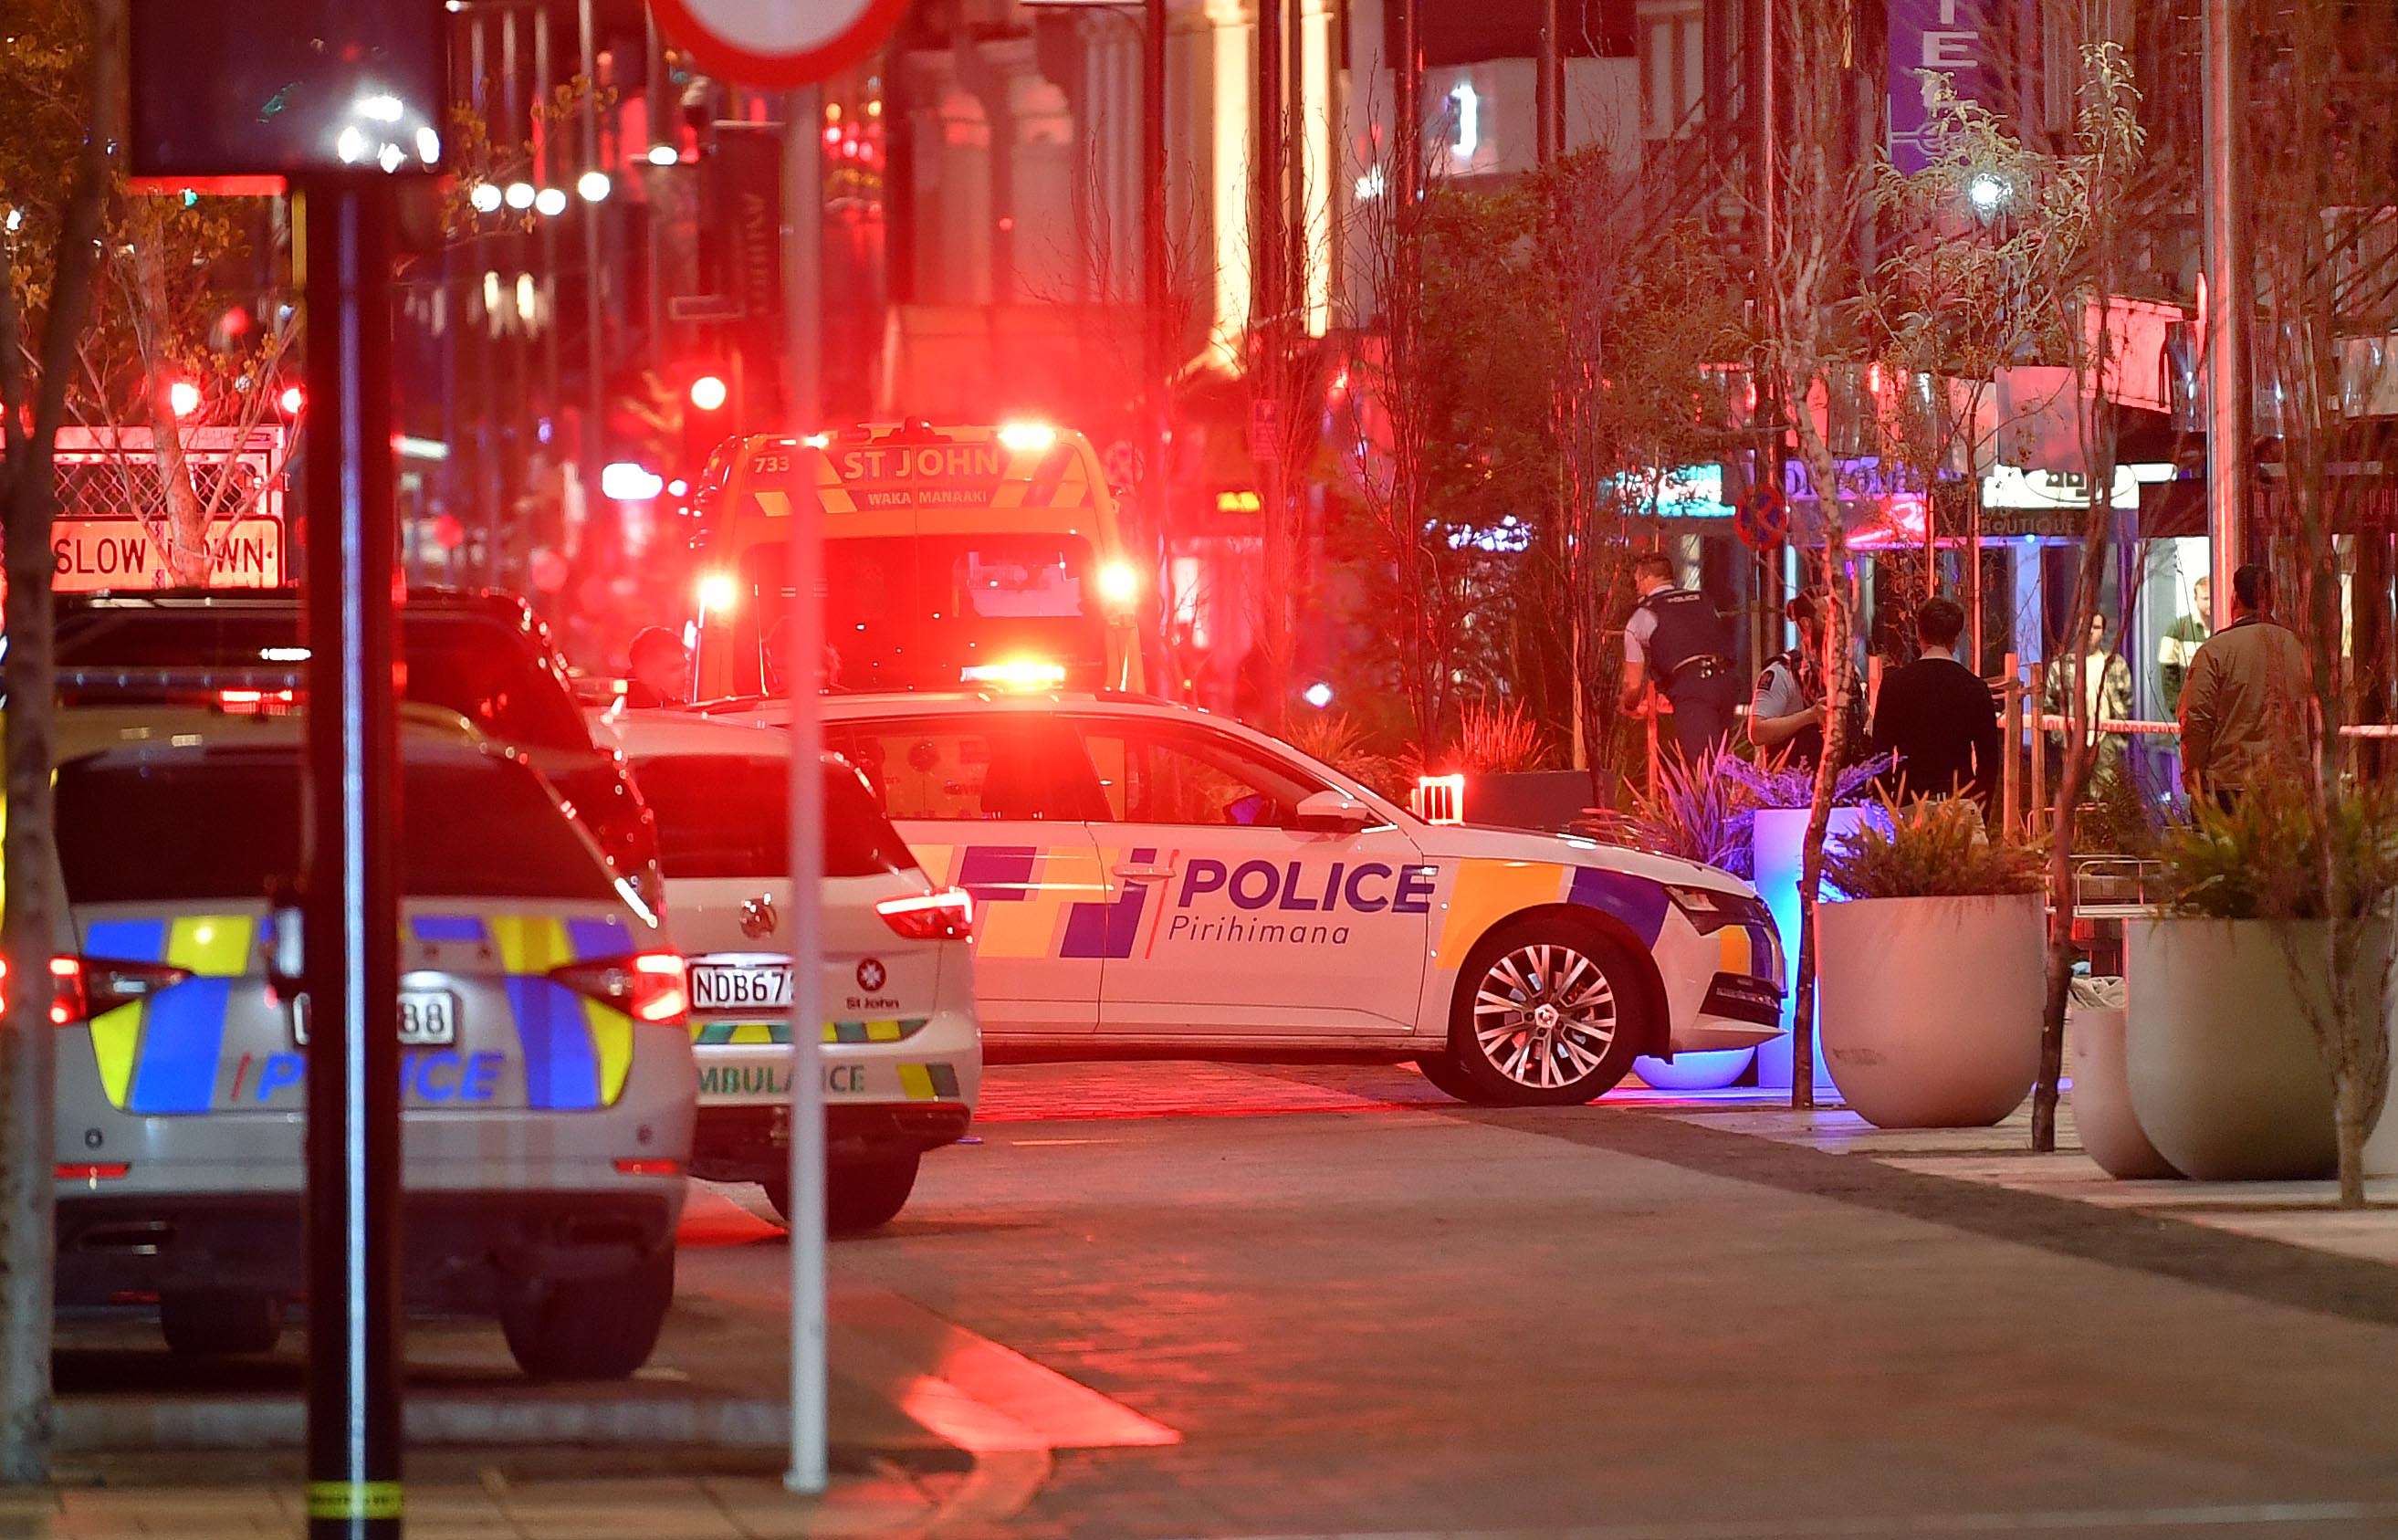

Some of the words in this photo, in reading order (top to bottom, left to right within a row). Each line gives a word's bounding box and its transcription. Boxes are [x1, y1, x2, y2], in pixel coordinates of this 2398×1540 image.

[754, 456, 791, 473] 733
[844, 450, 885, 479] ST
[895, 446, 998, 477] JOHN
[868, 491, 911, 506] WAKA
[918, 490, 987, 504] MANAAKI
[1980, 518, 2075, 534] BOUTIQUE
[54, 538, 146, 574] SLOW
[168, 538, 264, 574] WN
[1178, 859, 1440, 913] POLICE
[1168, 915, 1350, 944] Pirihimana
[696, 971, 794, 1002] NDB67
[846, 997, 861, 1010] St
[864, 997, 900, 1009] John
[257, 1052, 504, 1101] PICE
[698, 1064, 864, 1094] MBULCE
